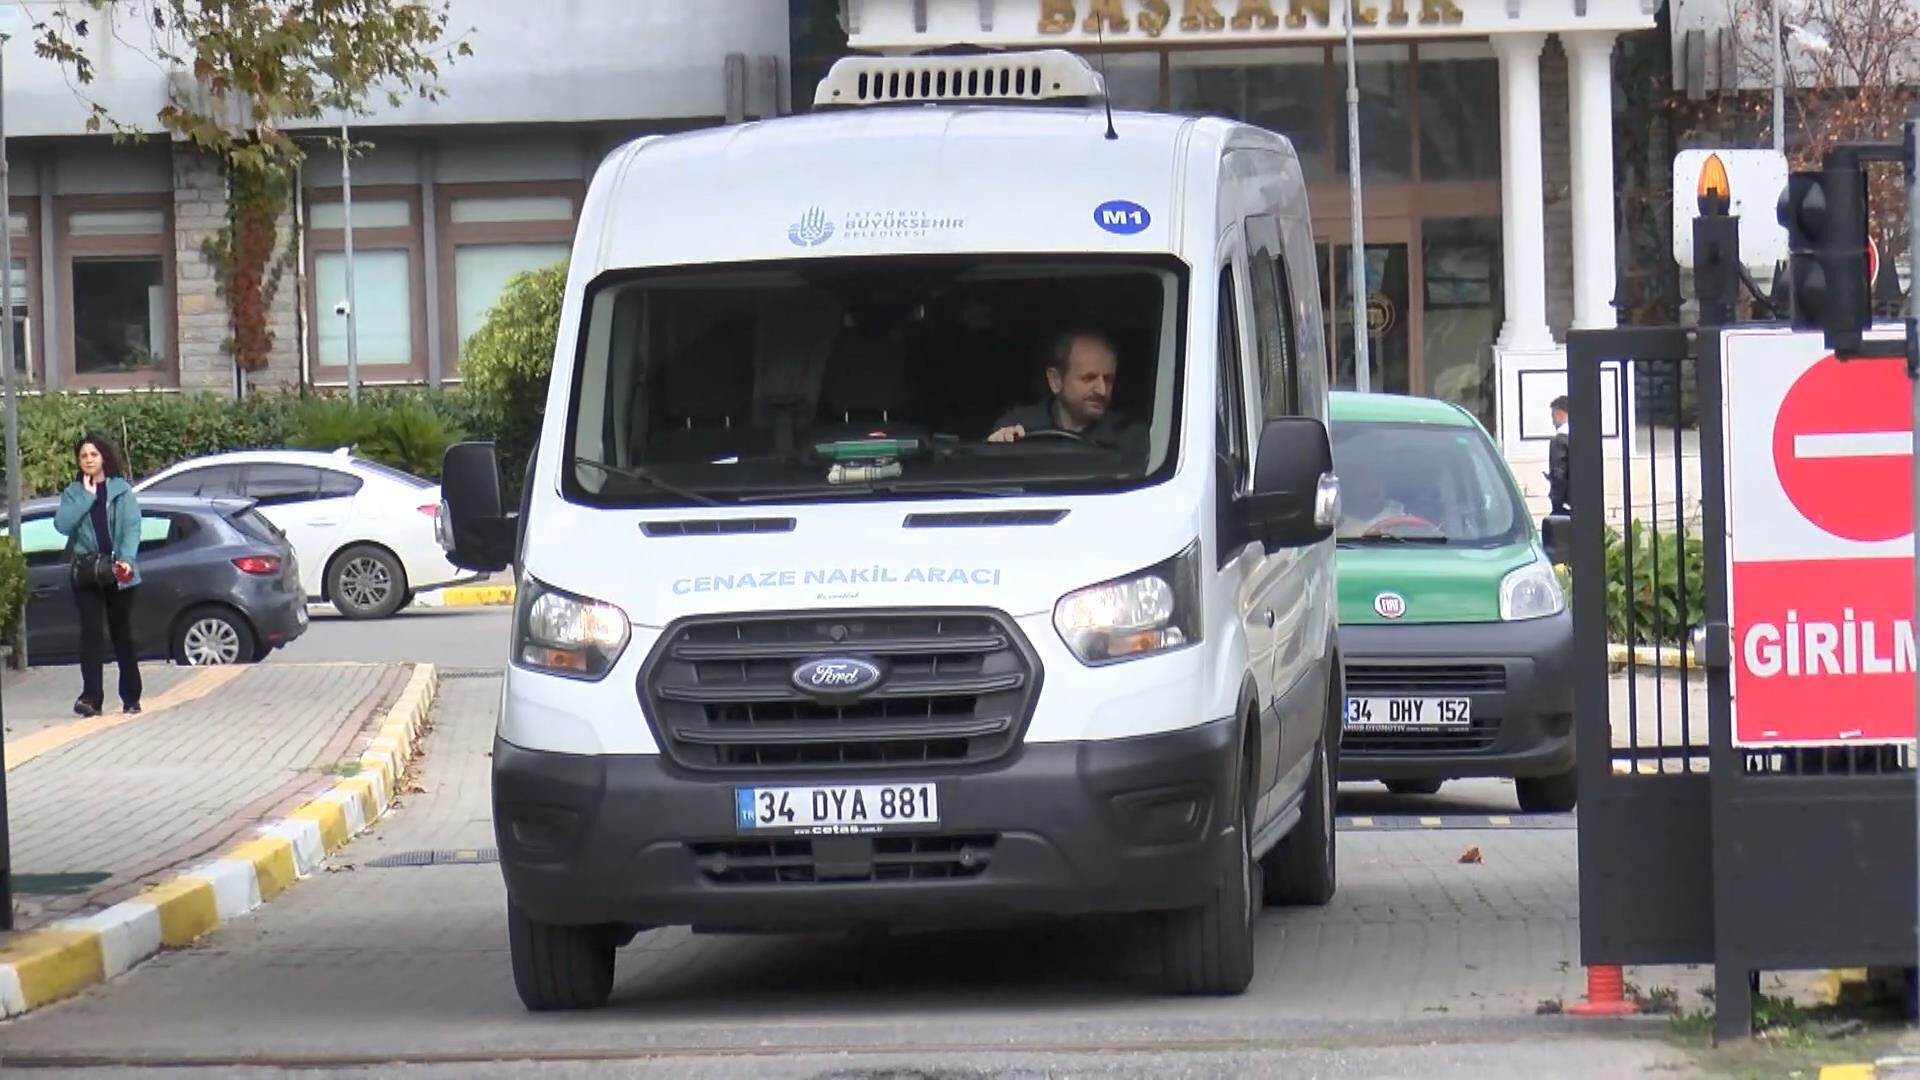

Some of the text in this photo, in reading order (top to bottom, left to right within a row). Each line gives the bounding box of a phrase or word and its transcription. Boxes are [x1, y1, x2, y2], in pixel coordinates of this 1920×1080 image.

[1102, 210, 1142, 225] M1
[672, 565, 1001, 595] CENAZE NAKİL ARACI
[812, 664, 859, 685] Ford
[1349, 699, 1468, 722] 34 DHY 152
[758, 786, 929, 823] 34 DYA 881
